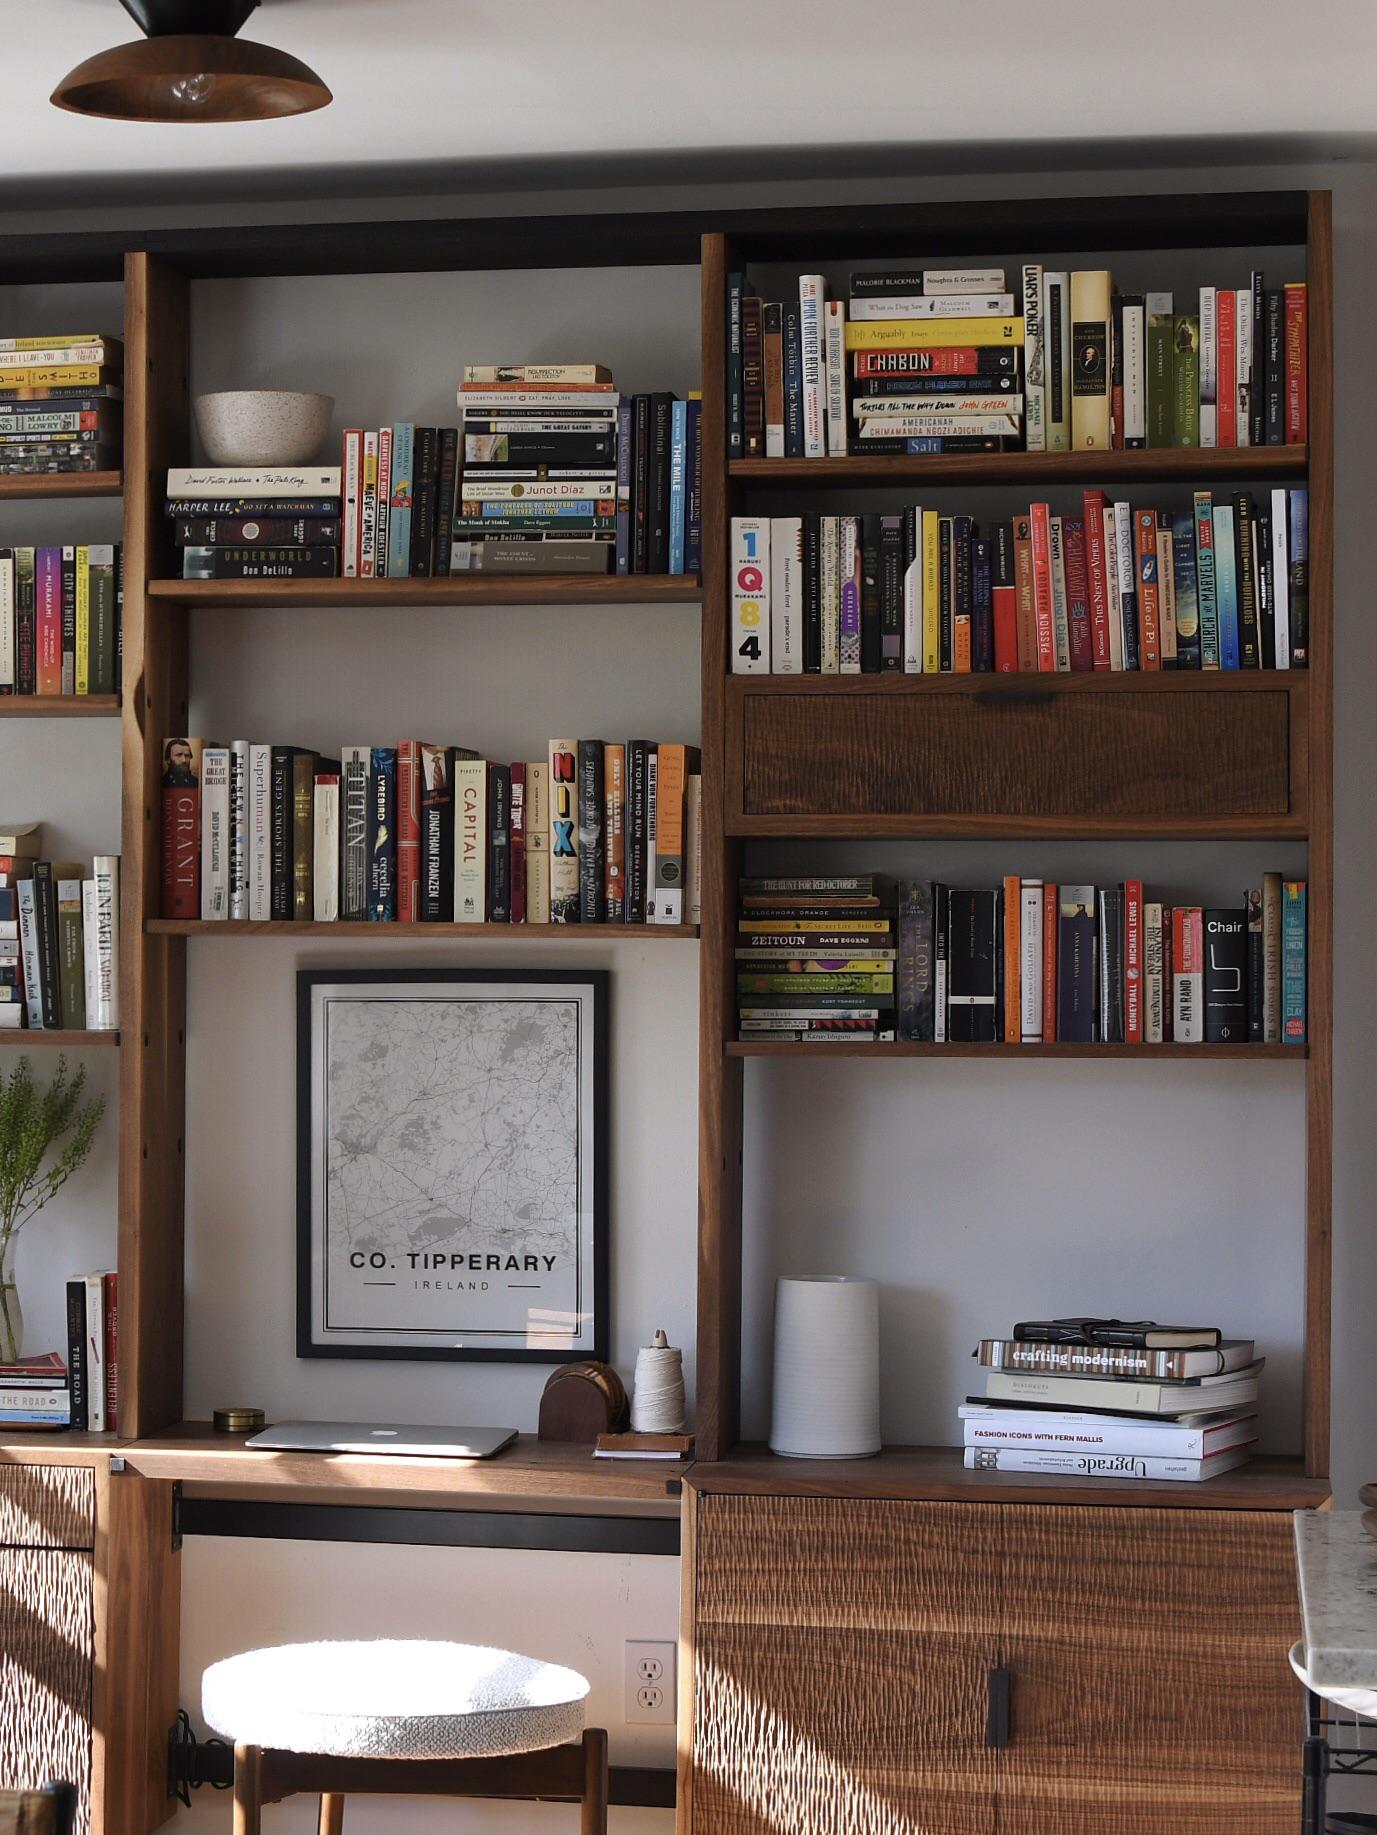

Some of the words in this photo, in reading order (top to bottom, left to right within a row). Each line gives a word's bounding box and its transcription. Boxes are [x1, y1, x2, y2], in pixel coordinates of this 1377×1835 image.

[856, 279, 883, 287] MALORIE
[1025, 267, 1038, 299] LIAR'S
[804, 299, 817, 320] UPON
[1269, 296, 1278, 311] Fifty
[787, 315, 796, 339] Colm
[1026, 301, 1039, 337] POKER
[1270, 313, 1278, 336] Shades
[804, 322, 818, 354] FURTHER
[872, 327, 905, 339] Arguably
[43, 353, 55, 361] YOU
[1271, 338, 1279, 363] Darker
[1288, 320, 1301, 376] SYMPATHIZER
[806, 357, 819, 385] REVIEW
[867, 353, 931, 371] CHABON
[789, 382, 797, 398] The
[888, 403, 901, 411] ALL
[959, 401, 979, 410] JOHN
[981, 400, 1009, 409] GREEN
[1027, 401, 1035, 422] LEWIS
[1033, 395, 1041, 426] MICHAEL
[28, 414, 73, 423] MALCOLM
[28, 421, 58, 430] LOWRY
[656, 404, 667, 456] Subliminal
[789, 403, 798, 435] Master
[870, 427, 924, 436] CHIMAMANDA
[926, 427, 952, 435] NGOZI
[381, 436, 389, 469] DARKNESS
[673, 444, 682, 464] THE
[912, 441, 938, 452] Salt
[381, 471, 387, 479] AT
[672, 467, 681, 492] MILE
[364, 483, 375, 511] MAEVE
[527, 485, 558, 496] Junot
[561, 484, 585, 495] Díaz
[169, 503, 209, 512] HARPER
[214, 503, 231, 511] LEE
[363, 519, 374, 555] AMERICA
[1051, 524, 1062, 559] Drown
[225, 552, 312, 562] UNDERWORLD
[1091, 538, 1099, 566] VIPERS
[1121, 531, 1130, 590] DOCTOROW
[243, 566, 258, 575] Don
[263, 566, 293, 575] DeLillo
[784, 558, 792, 571] ford
[1094, 569, 1100, 579] OF
[64, 573, 74, 590] CITY
[1201, 555, 1213, 602] MARVELS
[784, 595, 792, 608] ford
[1055, 590, 1064, 619] Junot
[1093, 582, 1103, 603] NEST
[1144, 589, 1154, 613] Life
[1243, 582, 1254, 625] BUFFALOES
[64, 606, 74, 637] THIEVES
[1095, 605, 1104, 626] THIS
[1145, 615, 1153, 626] of
[783, 616, 792, 640] parade's
[1040, 614, 1051, 653] PASSION
[1146, 631, 1155, 644] Pi
[237, 755, 245, 778] THE
[635, 750, 643, 764] LET
[207, 768, 226, 776] GREAT
[635, 767, 643, 790] YOUR
[649, 764, 657, 782] DIANE
[255, 752, 268, 833] Superhuman
[275, 770, 284, 800] GENE
[512, 784, 523, 806] WHITE
[237, 787, 245, 812] NEW
[347, 772, 366, 848] TITAN
[377, 776, 386, 821] LYREBIRD
[635, 793, 643, 817] MIND
[212, 812, 220, 830] DAVID
[275, 805, 284, 846] SPORTS
[464, 788, 477, 863] CAPITAL
[511, 808, 523, 830] TIGER
[648, 798, 656, 841] FURSTENBERG
[175, 798, 195, 888] GRANT
[428, 810, 440, 854] JONATHAN
[211, 831, 220, 873] McCULLOUGH
[275, 853, 284, 875] THE
[236, 852, 244, 892] THING
[371, 863, 381, 891] ahern
[379, 857, 391, 898] cecelia
[428, 857, 439, 898] FRANZEN
[97, 874, 112, 908] JOHN
[255, 885, 264, 915] Hooper
[22, 908, 33, 938] Dinner
[1129, 902, 1137, 926] LEWIS
[97, 912, 112, 956] BARTH
[1207, 922, 1243, 933] Chair
[752, 936, 807, 945] ZEITOUN
[937, 933, 945, 947] INTO
[1129, 929, 1137, 963] MICHAEL
[26, 951, 36, 982] Herman
[915, 944, 928, 993] LORD
[27, 984, 38, 1001] Koch
[903, 957, 914, 1012] RINGS
[1180, 980, 1193, 1002] RAND
[1129, 985, 1137, 1031] MONEYBALL
[1150, 979, 1160, 1028] HEMINGWAY
[1180, 1007, 1193, 1022] AYN
[349, 1251, 396, 1270] CO.
[407, 1253, 558, 1273] TIPPERARY
[414, 1280, 490, 1292] IRELAND
[1013, 1349, 1068, 1367] crafting
[1072, 1354, 1148, 1369] modernism
[74, 1374, 82, 1404] ROAD
[2, 1397, 18, 1405] THE
[23, 1397, 47, 1406] ROAD
[974, 1430, 1007, 1438] FASHION
[1009, 1432, 1033, 1440] ICONS
[1079, 1458, 1147, 1477] Upgrade
